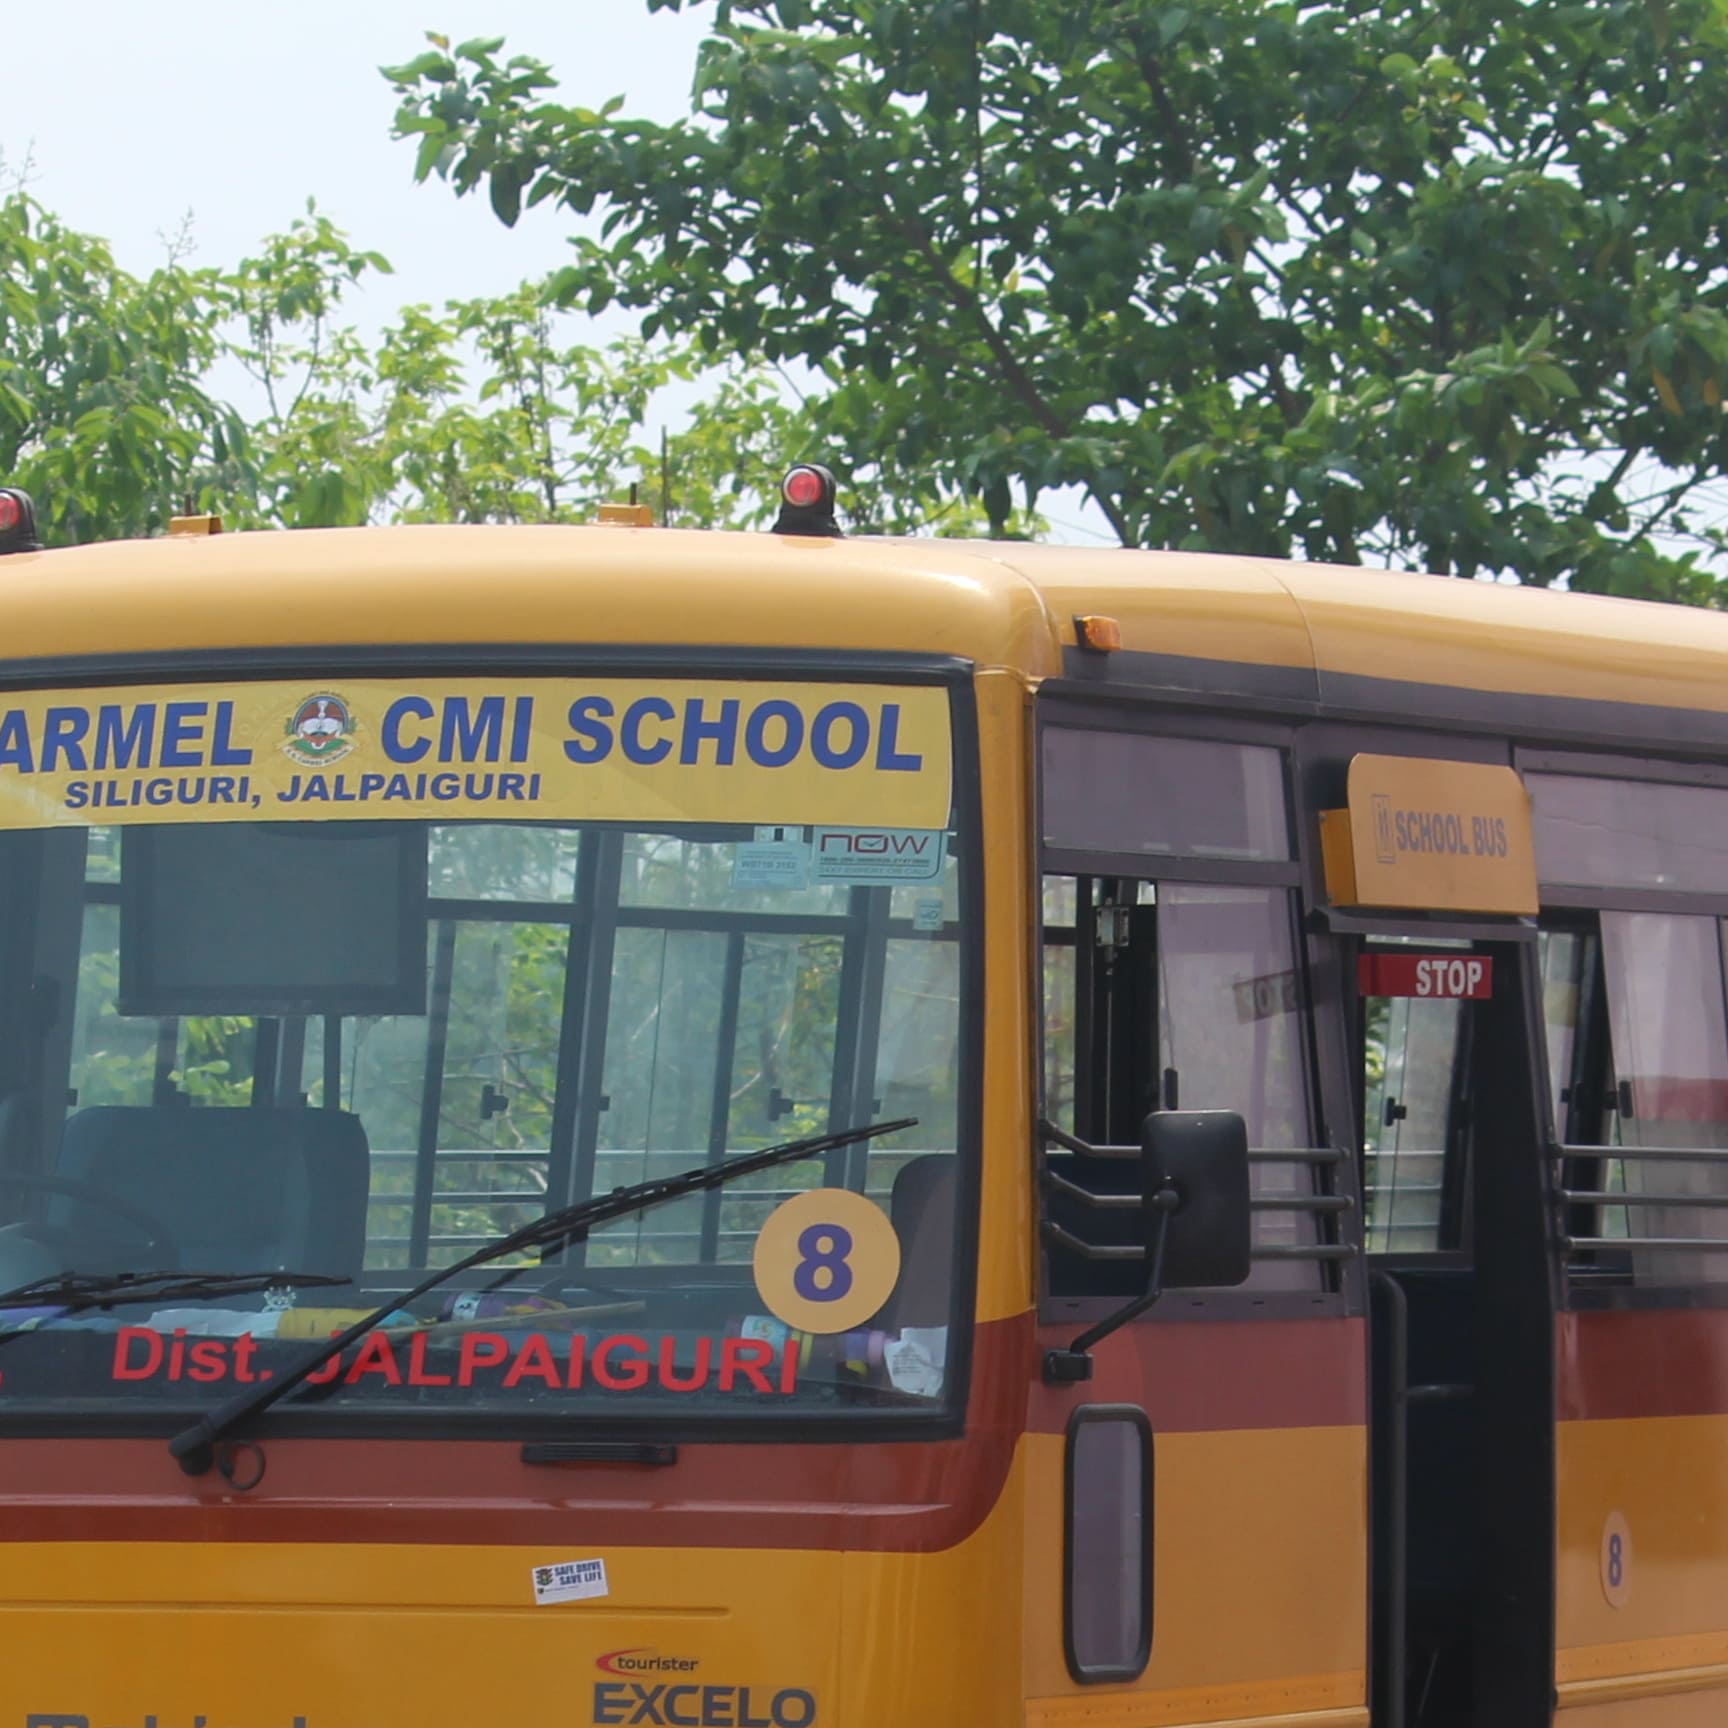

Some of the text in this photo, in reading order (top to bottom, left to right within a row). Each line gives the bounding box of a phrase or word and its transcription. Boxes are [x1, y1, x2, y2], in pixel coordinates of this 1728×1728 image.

[380, 695, 535, 763] CMI
[563, 695, 924, 773] SCHOOL
[64, 773, 542, 809] SILIGURI, JALPAIGURI
[1394, 810, 1507, 858] SCHOOL BUS
[1415, 959, 1483, 996] STOP
[793, 1223, 854, 1302] 8
[112, 1327, 275, 1383] Dist.
[305, 1329, 800, 1394] JALPAIGURI
[1609, 1533, 1622, 1587] 8
[618, 1655, 700, 1673] tourister
